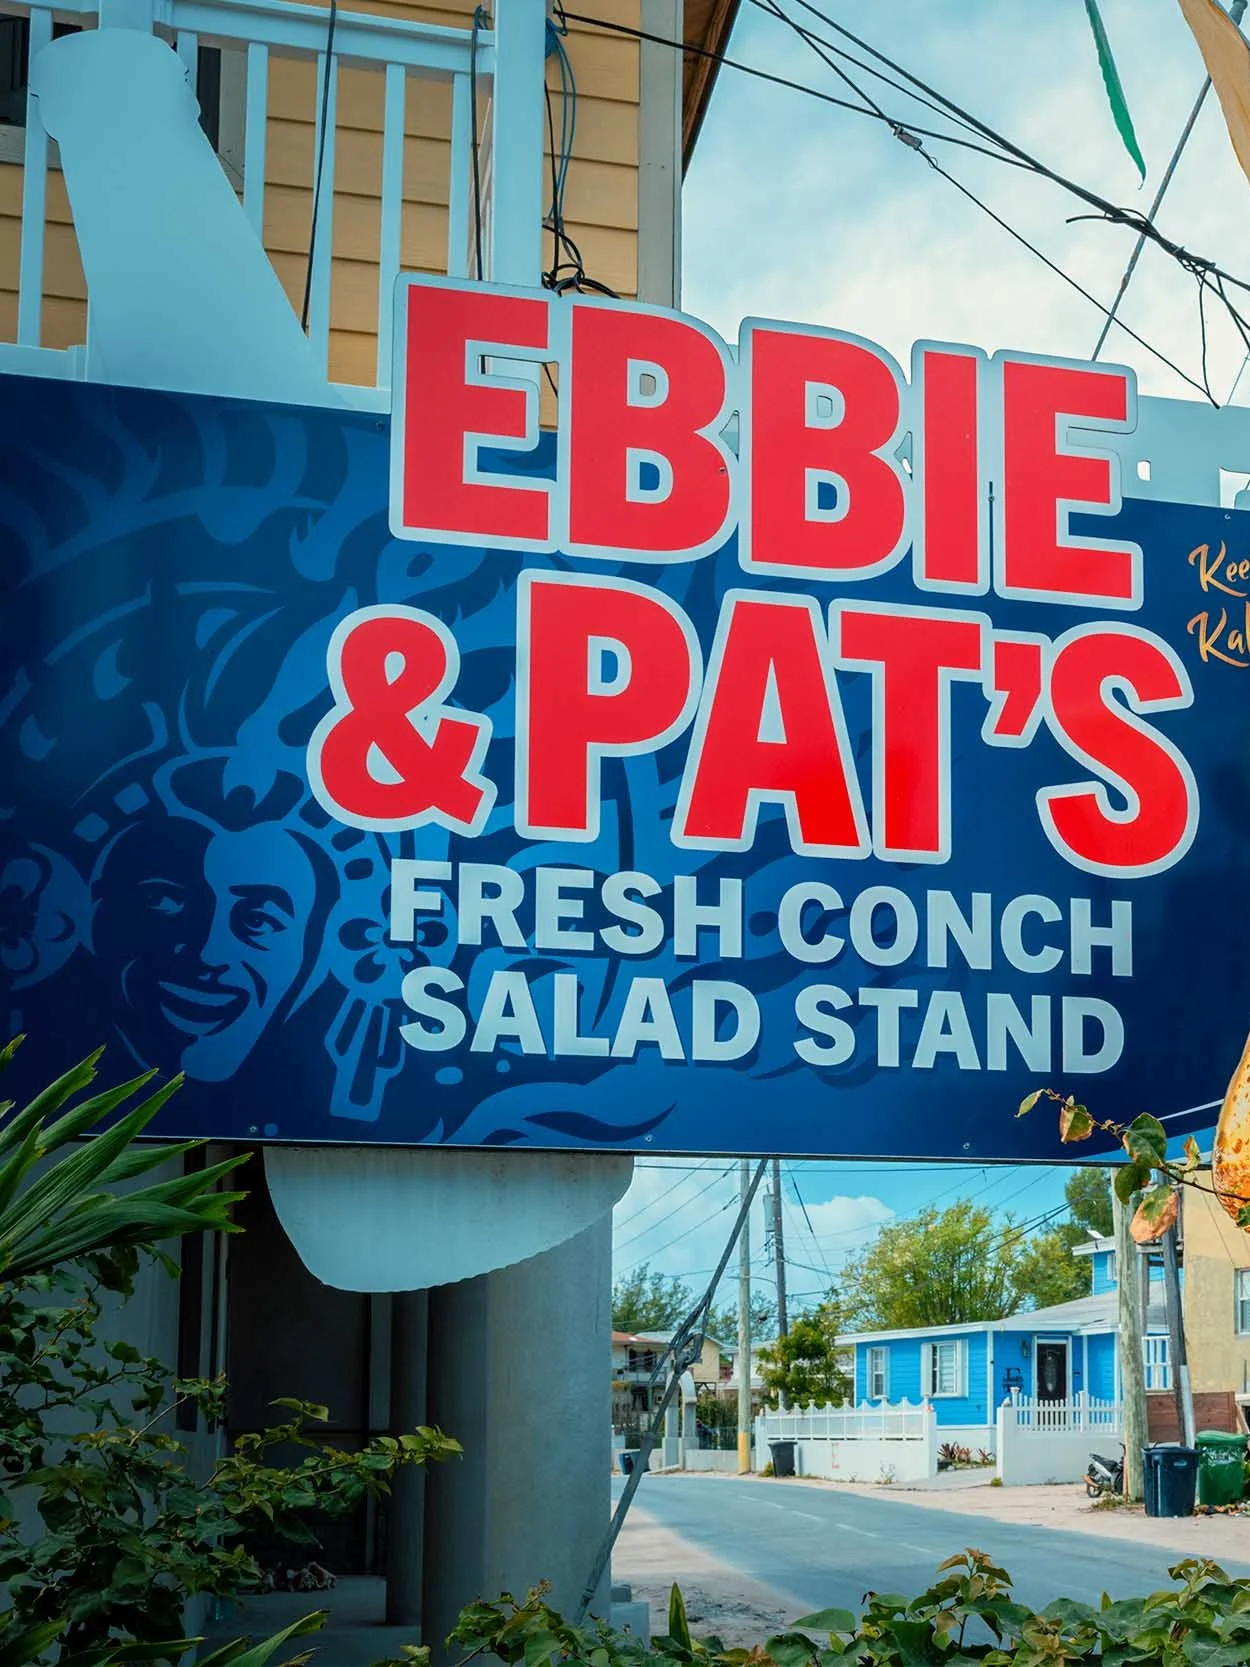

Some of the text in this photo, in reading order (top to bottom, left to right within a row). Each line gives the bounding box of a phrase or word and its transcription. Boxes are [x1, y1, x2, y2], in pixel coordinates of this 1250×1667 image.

[404, 284, 1132, 600] EBBIE
[321, 582, 1188, 867] & PAT'S
[390, 859, 1133, 977] FRESH CONCH
[399, 967, 1125, 1074] SALAD STAND
